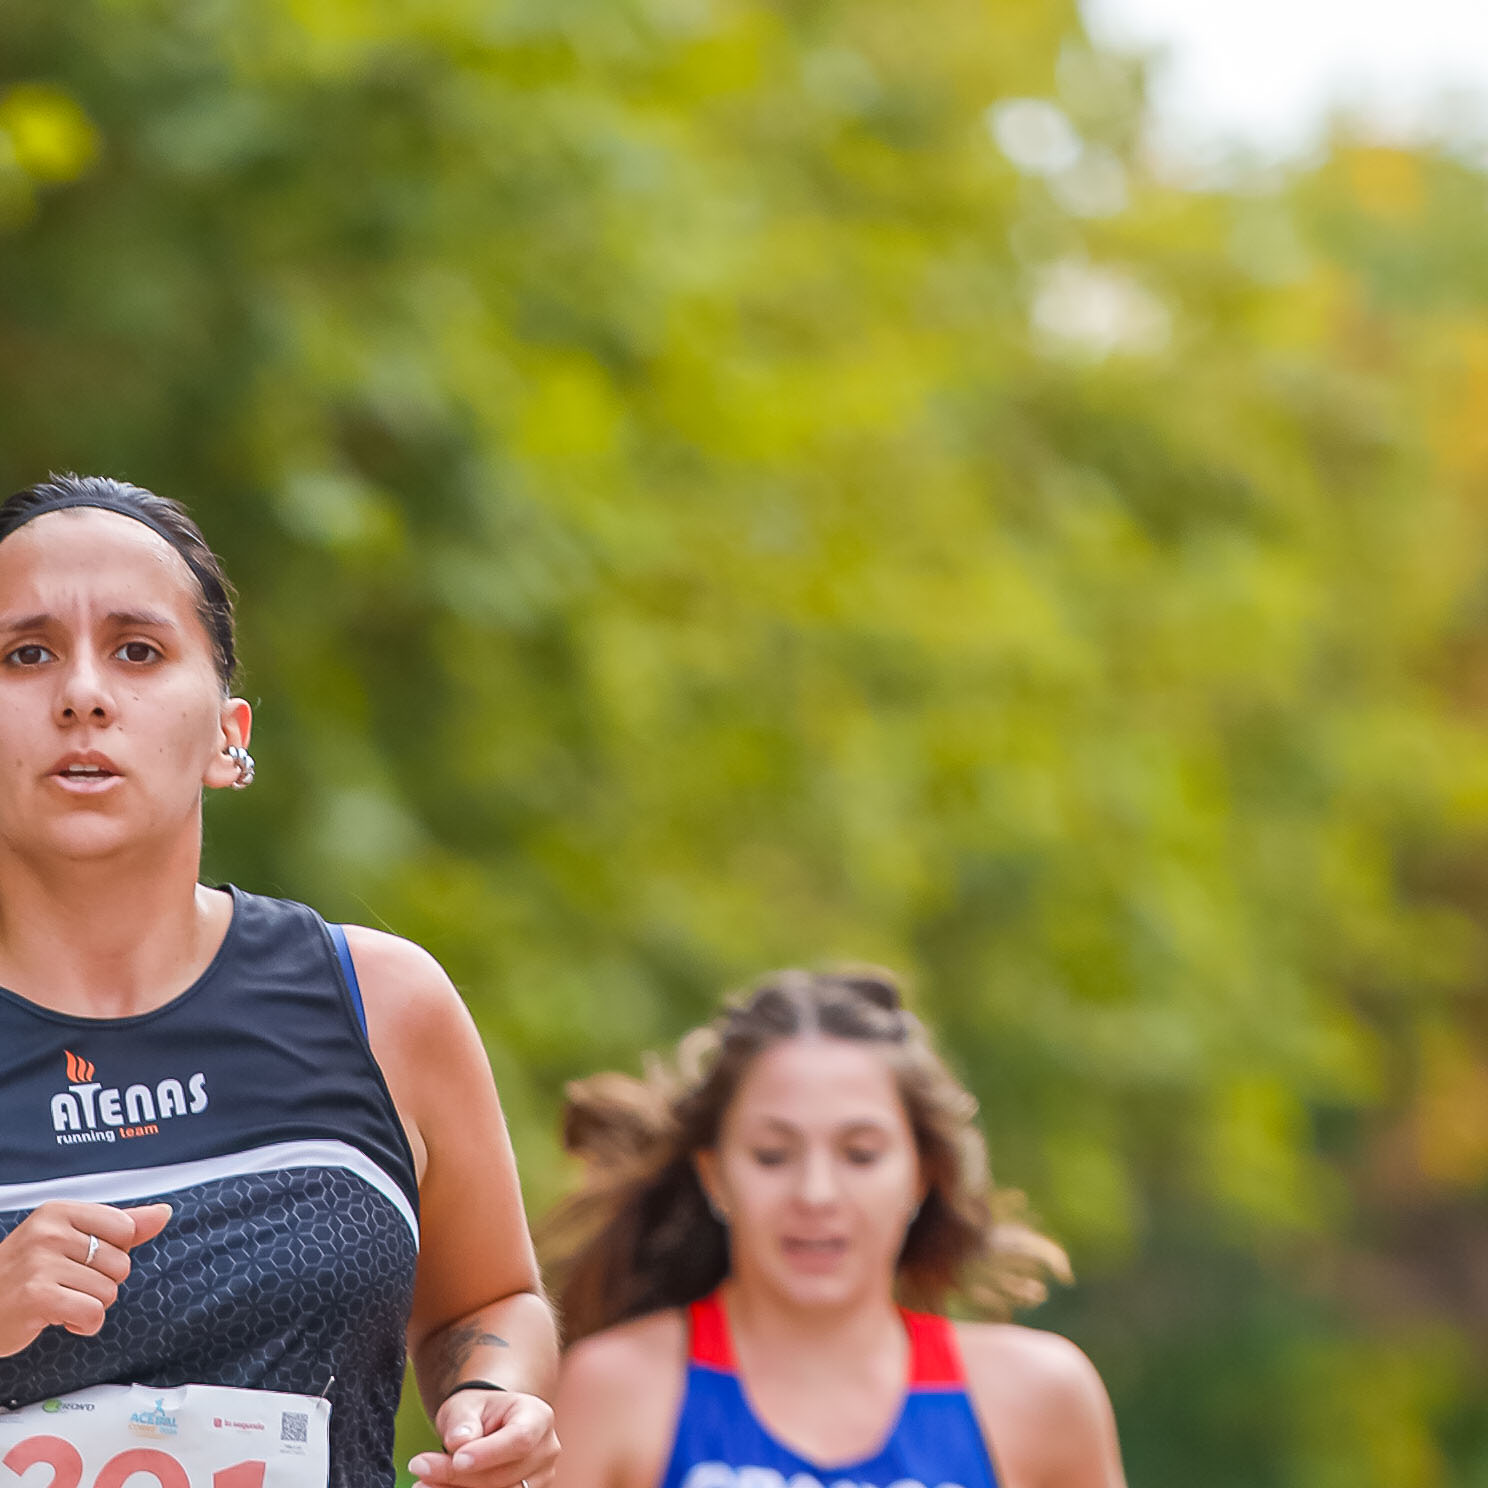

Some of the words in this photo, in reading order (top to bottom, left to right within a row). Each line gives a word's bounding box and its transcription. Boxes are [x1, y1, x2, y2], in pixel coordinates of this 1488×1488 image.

[51, 1073, 208, 1131] ATENAS
[56, 1129, 116, 1145] running
[119, 1124, 159, 1139] team
